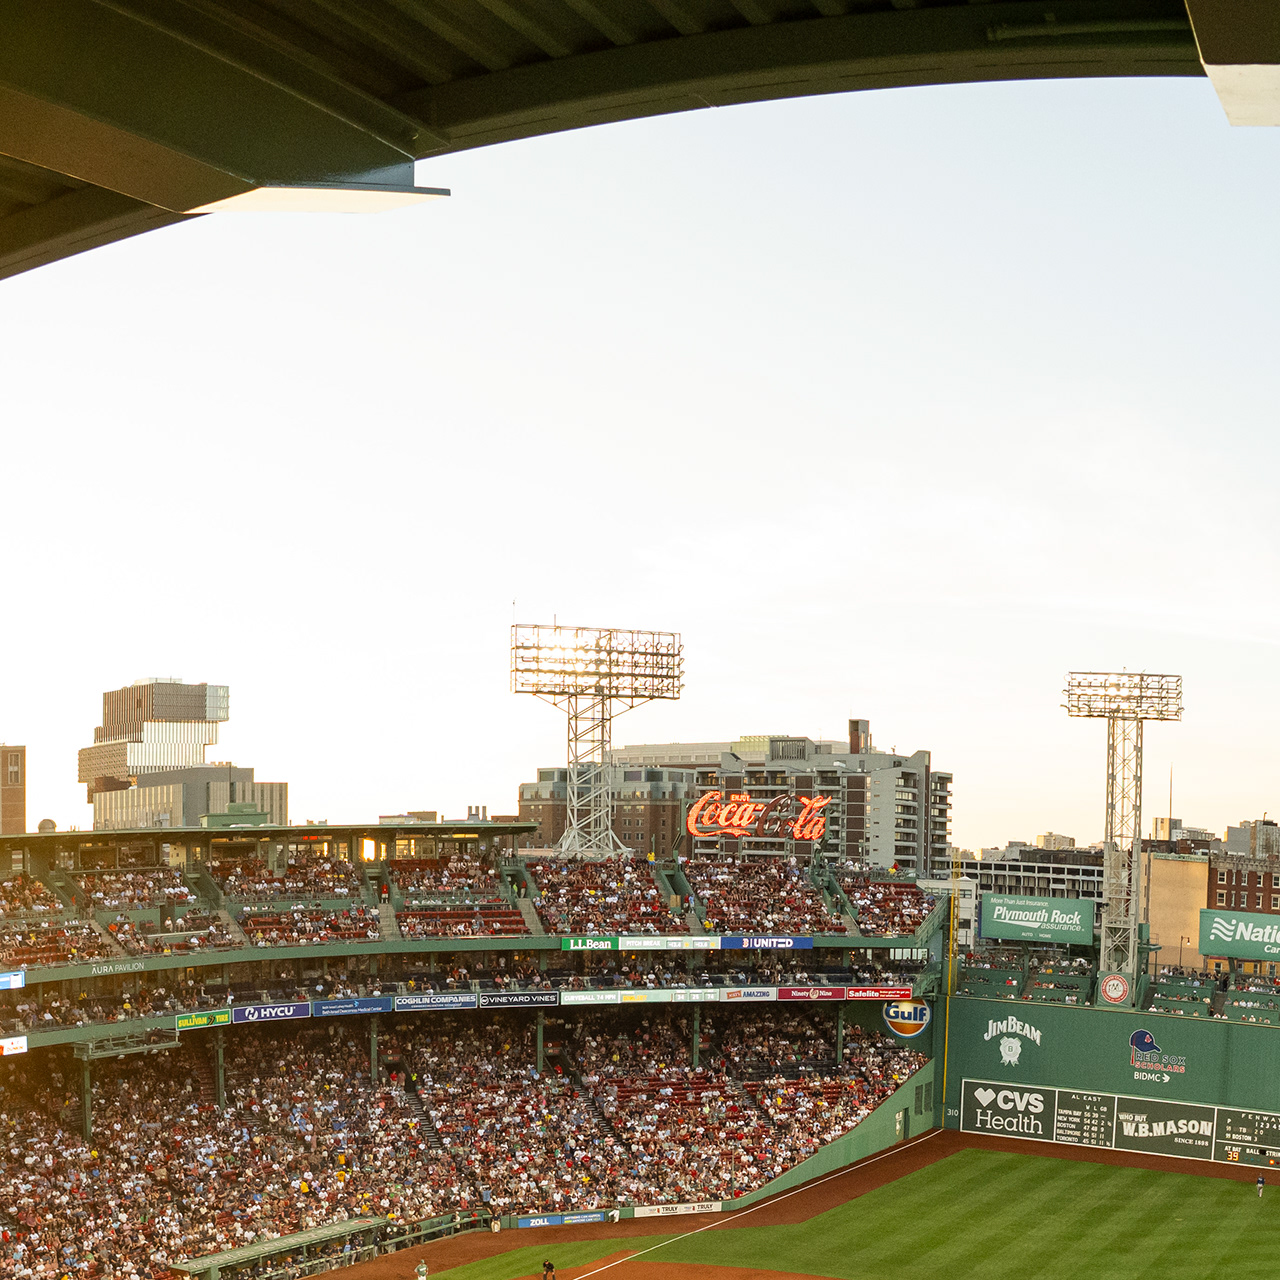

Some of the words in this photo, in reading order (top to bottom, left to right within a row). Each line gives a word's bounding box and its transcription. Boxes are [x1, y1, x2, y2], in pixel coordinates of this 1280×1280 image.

[730, 794, 751, 802] ENJOY
[686, 791, 832, 840] Coca-Cola
[994, 906, 1048, 922] Plymouth
[1051, 910, 1082, 925] Rock
[570, 939, 612, 950] L.L.Bean
[1264, 944, 1280, 954] Car
[115, 962, 145, 972] PAVILION
[431, 995, 476, 1004] COMPANIES
[848, 990, 880, 998] Safelite
[260, 1006, 294, 1018] HYCU
[884, 1004, 928, 1022] Gulf
[178, 1014, 208, 1028] SULLIVAN
[216, 1014, 229, 1023] TIRE
[1007, 1015, 1042, 1046] BEAM
[1136, 1052, 1158, 1062] RED
[1162, 1054, 1186, 1066] SOX
[1134, 1061, 1186, 1073] SCHOLARS
[1134, 1071, 1161, 1082] BIDMC
[996, 1089, 1044, 1114] CVS
[947, 1108, 959, 1116] 310
[975, 1109, 1043, 1134] Health
[1122, 1120, 1213, 1137] W.B.MASON
[1232, 1133, 1252, 1141] BOSTON
[1227, 1151, 1239, 1161] 39
